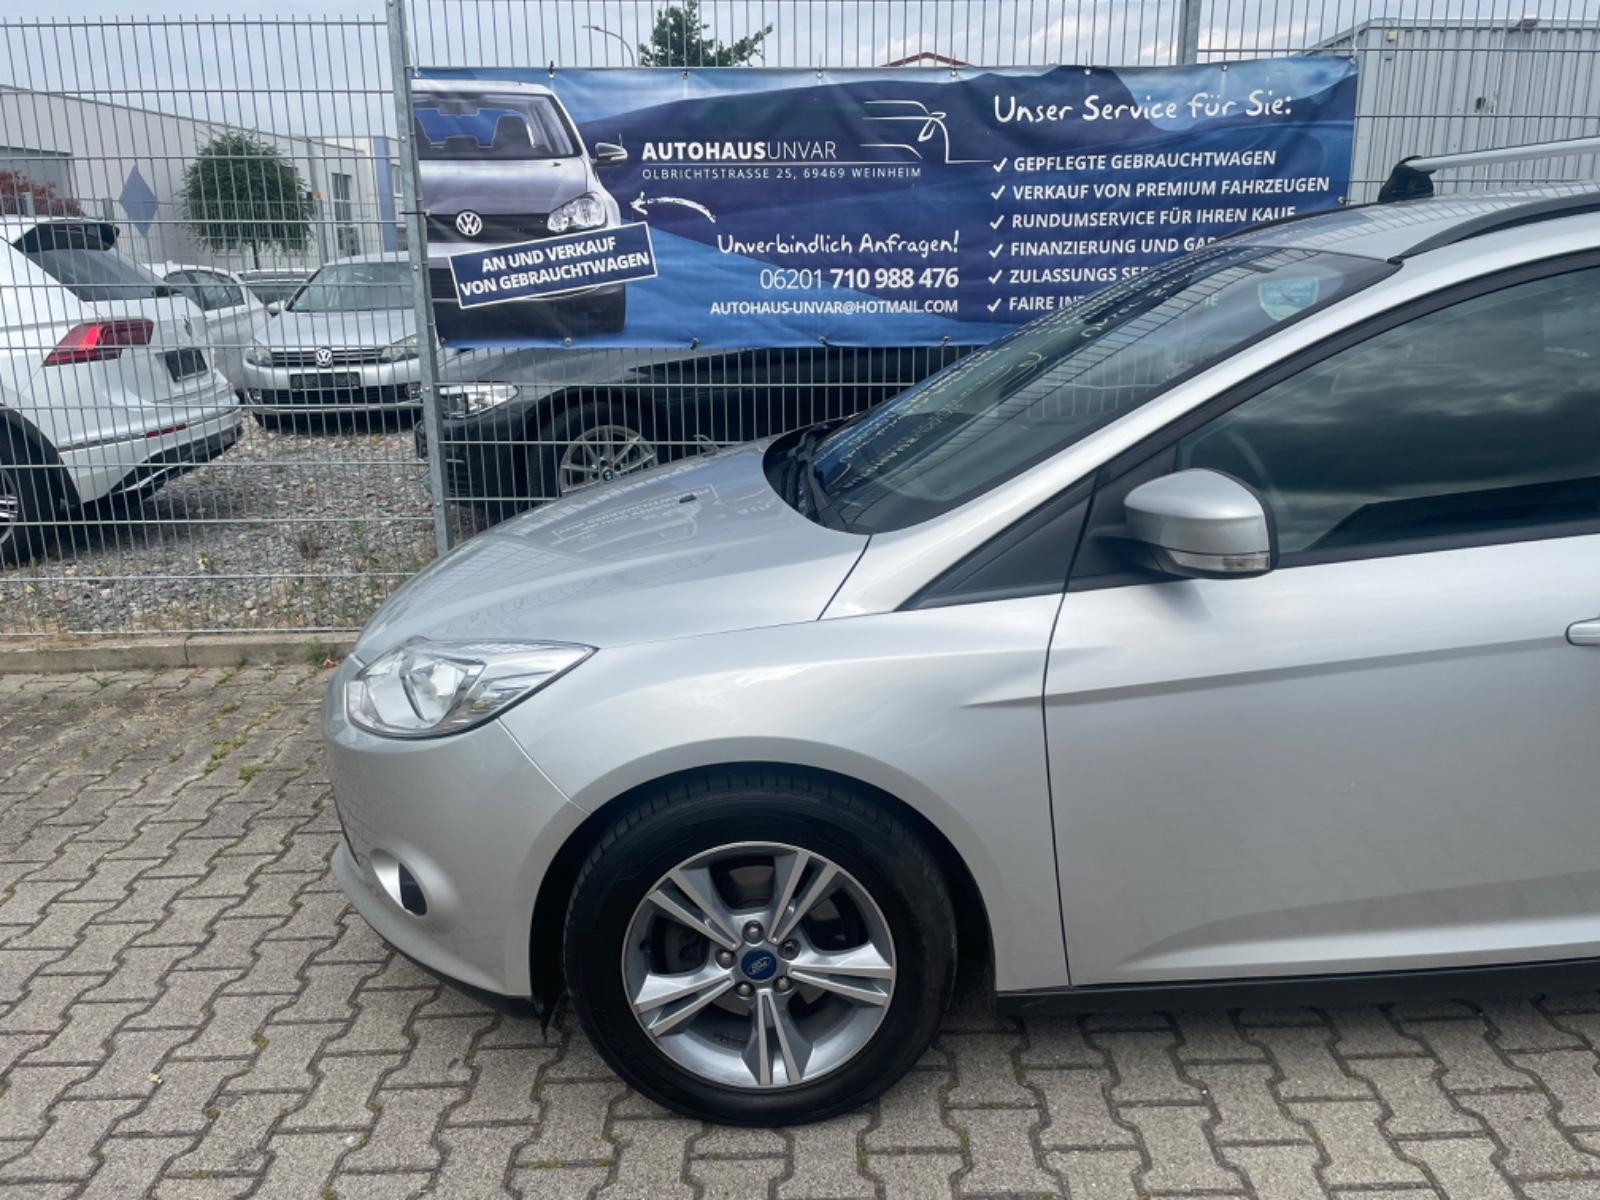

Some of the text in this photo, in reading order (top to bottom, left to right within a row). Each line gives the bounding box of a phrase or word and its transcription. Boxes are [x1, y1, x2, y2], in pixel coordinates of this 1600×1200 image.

[993, 89, 1293, 124] Unser Service für Sie:
[1013, 150, 1277, 172] GEPFLEGTE GEBRAUCHTWAGEN
[642, 167, 922, 181] OLBRICHTSTRASSE 25, 69469 WEINHEIM
[1012, 177, 1331, 200] VERKAUF VON PREMIUM FAHRZEUGEN
[1012, 205, 1297, 229] RUNDUMSERVICE FÜR IHREN KAUF
[481, 235, 617, 274] AN UND VERKAUF
[717, 229, 961, 259] Unverbindlich Anfragen!
[1010, 239, 1137, 257] FINANZIERUNG
[1141, 237, 1179, 254] UND
[459, 251, 651, 297] VON GEBRAUCHTWAGEN
[759, 267, 960, 290] 06201 710 988 476
[1009, 266, 1118, 284] ZULASSUNGS
[709, 299, 959, 316] AUTOHAUS-UNVAR@HOTMAIL.COM
[1008, 295, 1055, 311] FAIRE
